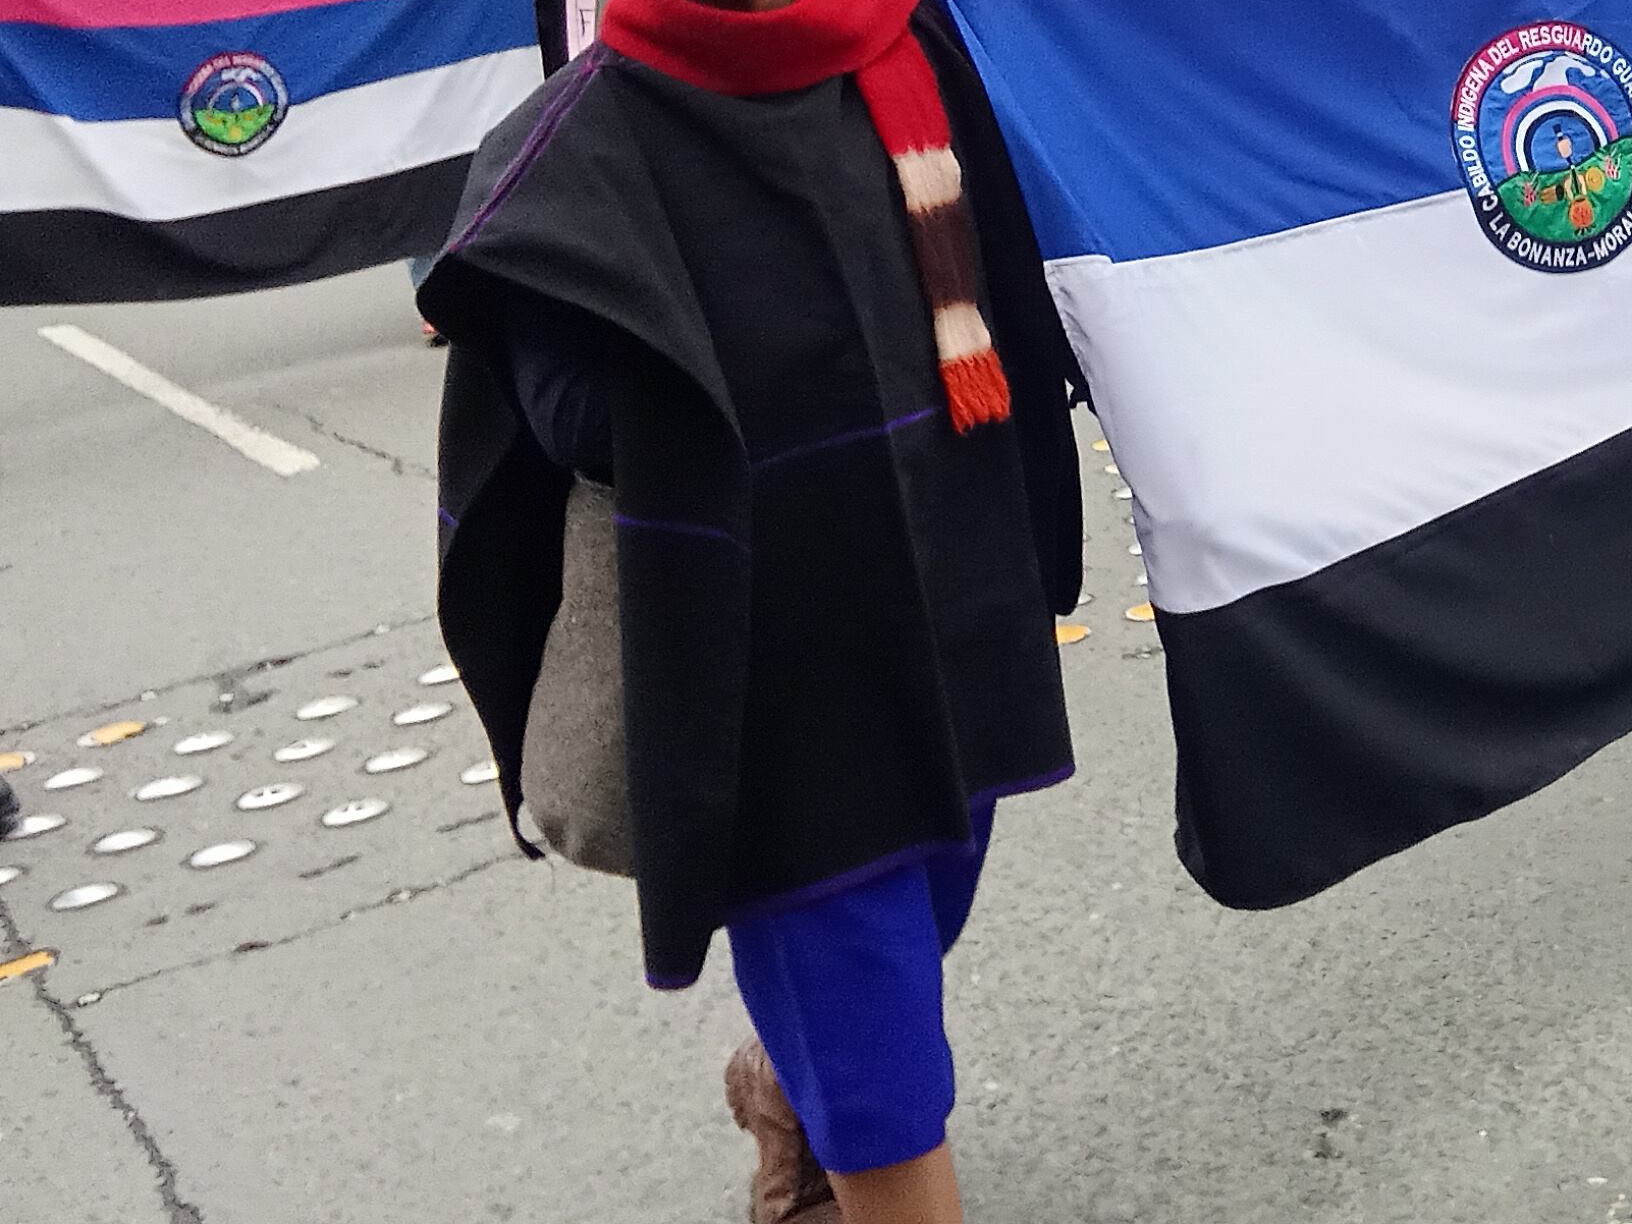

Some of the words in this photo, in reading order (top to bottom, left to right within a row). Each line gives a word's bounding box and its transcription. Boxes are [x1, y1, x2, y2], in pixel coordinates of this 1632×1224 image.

[1488, 37, 1520, 67] DEL
[1518, 25, 1614, 64] RESGUARDO
[1457, 60, 1497, 133] INDIGENA
[1457, 135, 1499, 212] CABILDO
[1488, 211, 1508, 242] LA
